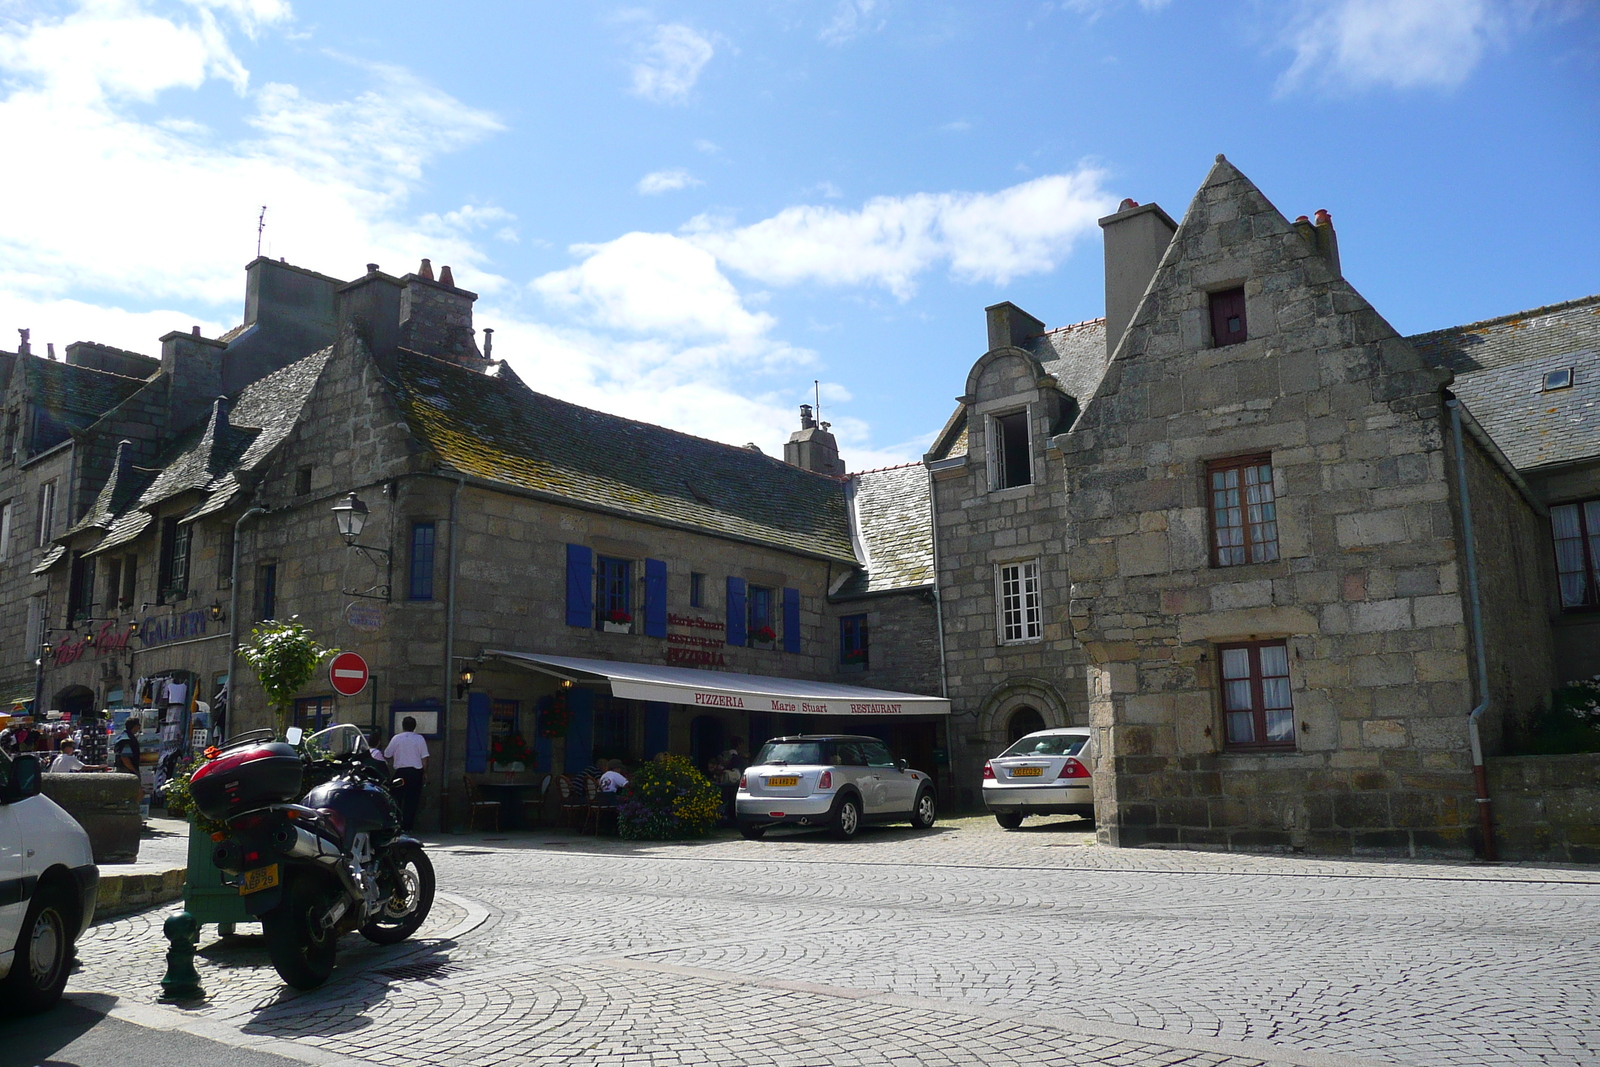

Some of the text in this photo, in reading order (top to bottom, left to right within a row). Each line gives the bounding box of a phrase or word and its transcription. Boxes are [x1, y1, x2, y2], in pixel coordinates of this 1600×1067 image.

[668, 613, 725, 631] Marie Stuart
[667, 633, 726, 649] RESTAURANT
[53, 635, 85, 667] Fast
[667, 647, 726, 667] PIZZERIA
[695, 692, 744, 708] PIZZERIA
[771, 699, 827, 713] Marie Stuart
[850, 703, 902, 714] RESTAURANT
[261, 875, 274, 886] 29
